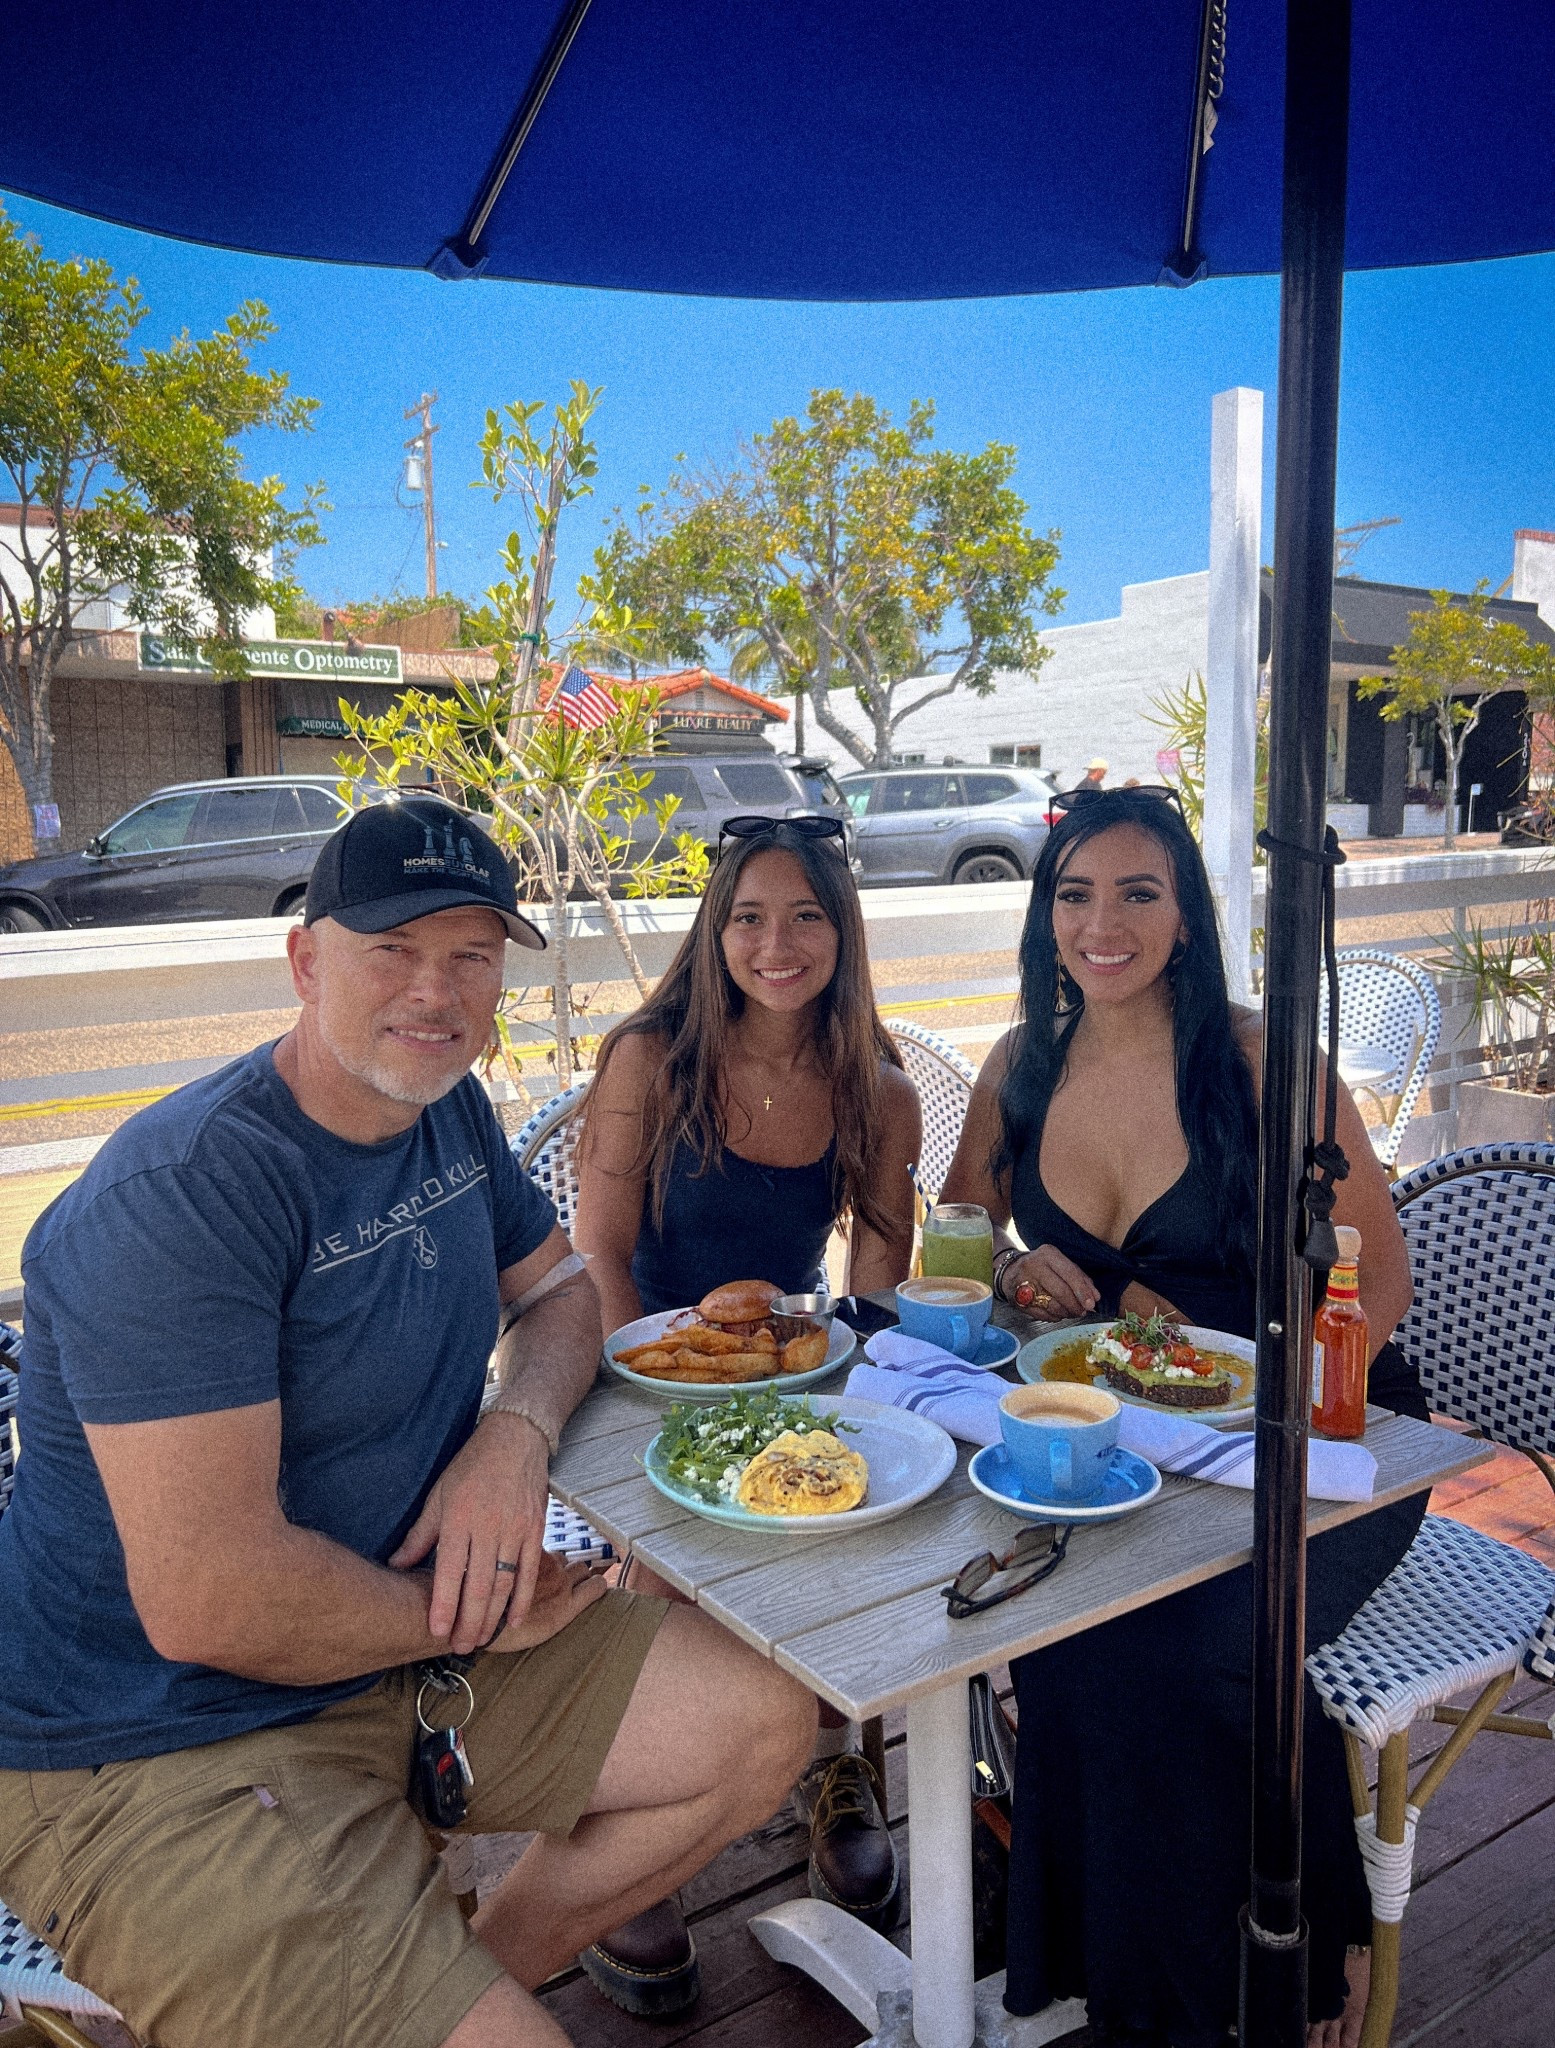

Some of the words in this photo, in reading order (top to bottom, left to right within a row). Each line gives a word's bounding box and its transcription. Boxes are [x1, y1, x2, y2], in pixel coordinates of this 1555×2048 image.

[294, 648, 393, 675] Optometry
[301, 719, 342, 731] MEDICAL
[716, 718, 753, 731] REALTY
[445, 1154, 486, 1187] KILL
